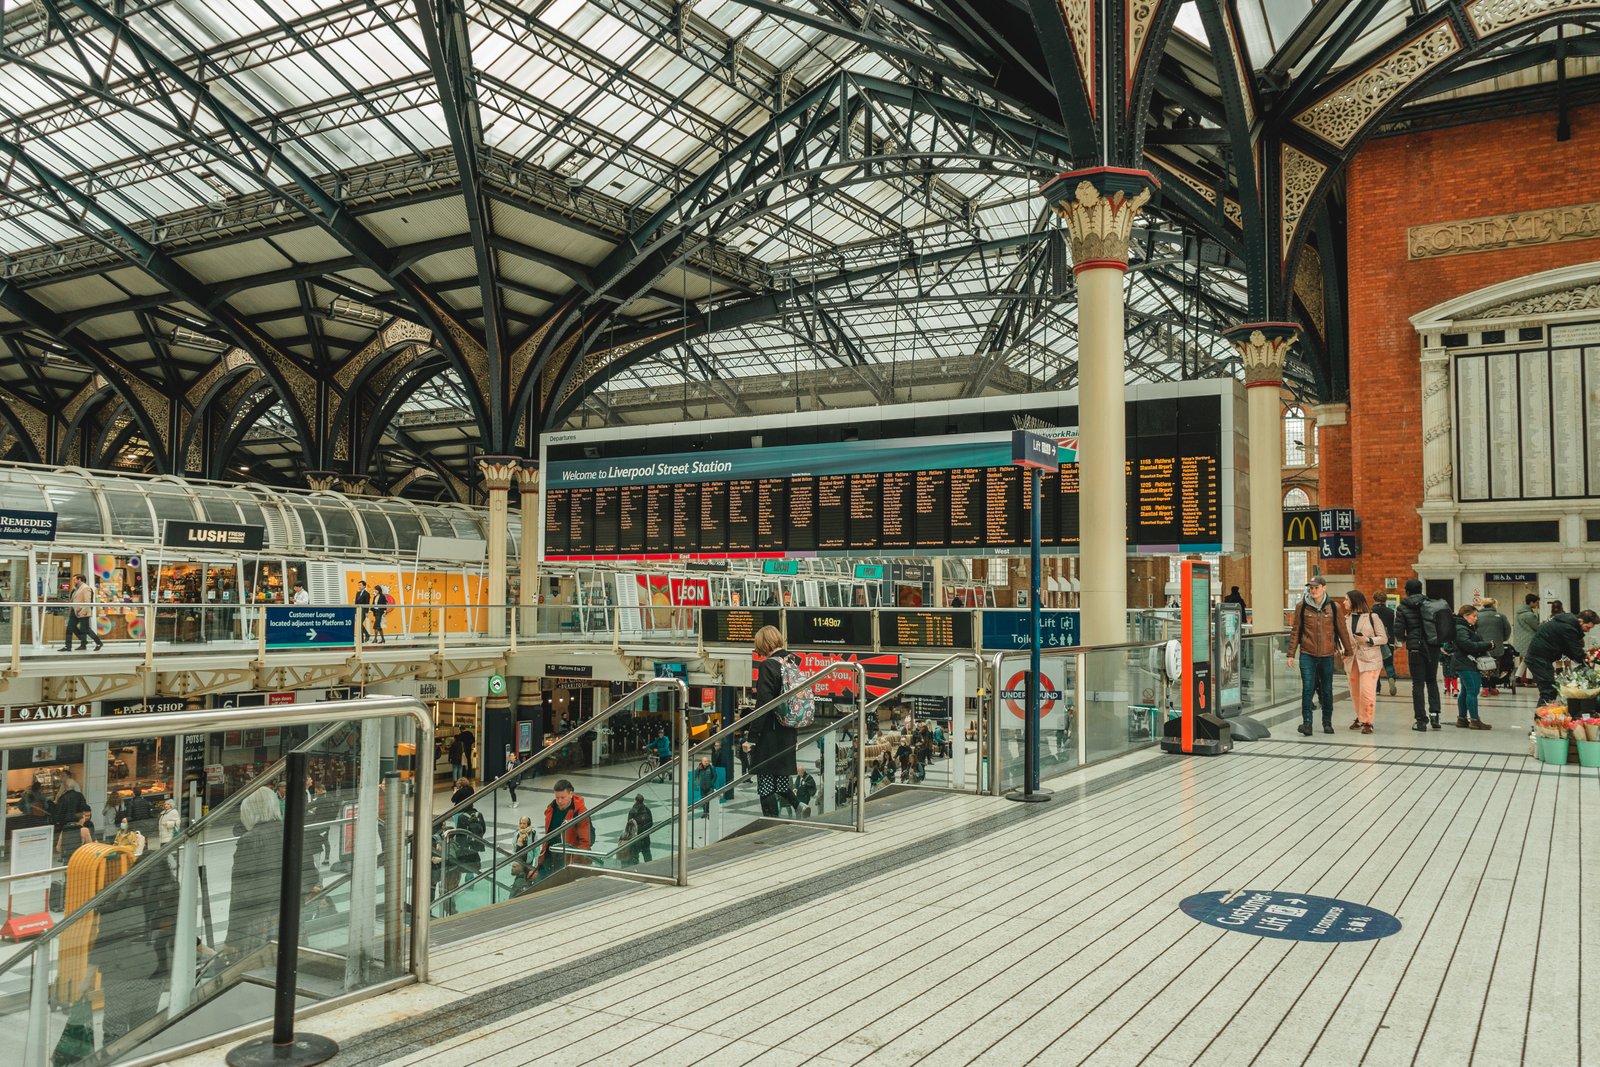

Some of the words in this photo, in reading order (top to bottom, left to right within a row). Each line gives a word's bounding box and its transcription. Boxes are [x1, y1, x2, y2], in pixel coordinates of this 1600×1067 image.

[1431, 216, 1541, 250] GREAT
[550, 434, 577, 442] Departures
[562, 470, 597, 481] Welcome
[598, 469, 607, 479] to
[608, 464, 656, 480] Liverpool
[656, 462, 689, 476] Street
[691, 460, 732, 474] Station
[0, 516, 53, 528] REMEDIES
[31, 528, 51, 536] Beauty
[188, 528, 228, 543] LUSH
[677, 585, 705, 600] LEON
[315, 611, 336, 619] Lounge
[1039, 618, 1056, 628] Lift
[1011, 633, 1044, 644] Toils
[805, 656, 814, 666] If
[832, 672, 851, 682] you,
[815, 683, 829, 692] get
[33, 704, 76, 720] AMT
[123, 704, 156, 714] PAY
[157, 703, 184, 712] SHOP
[1216, 892, 1272, 925] Customer
[1254, 916, 1293, 932] Lift
